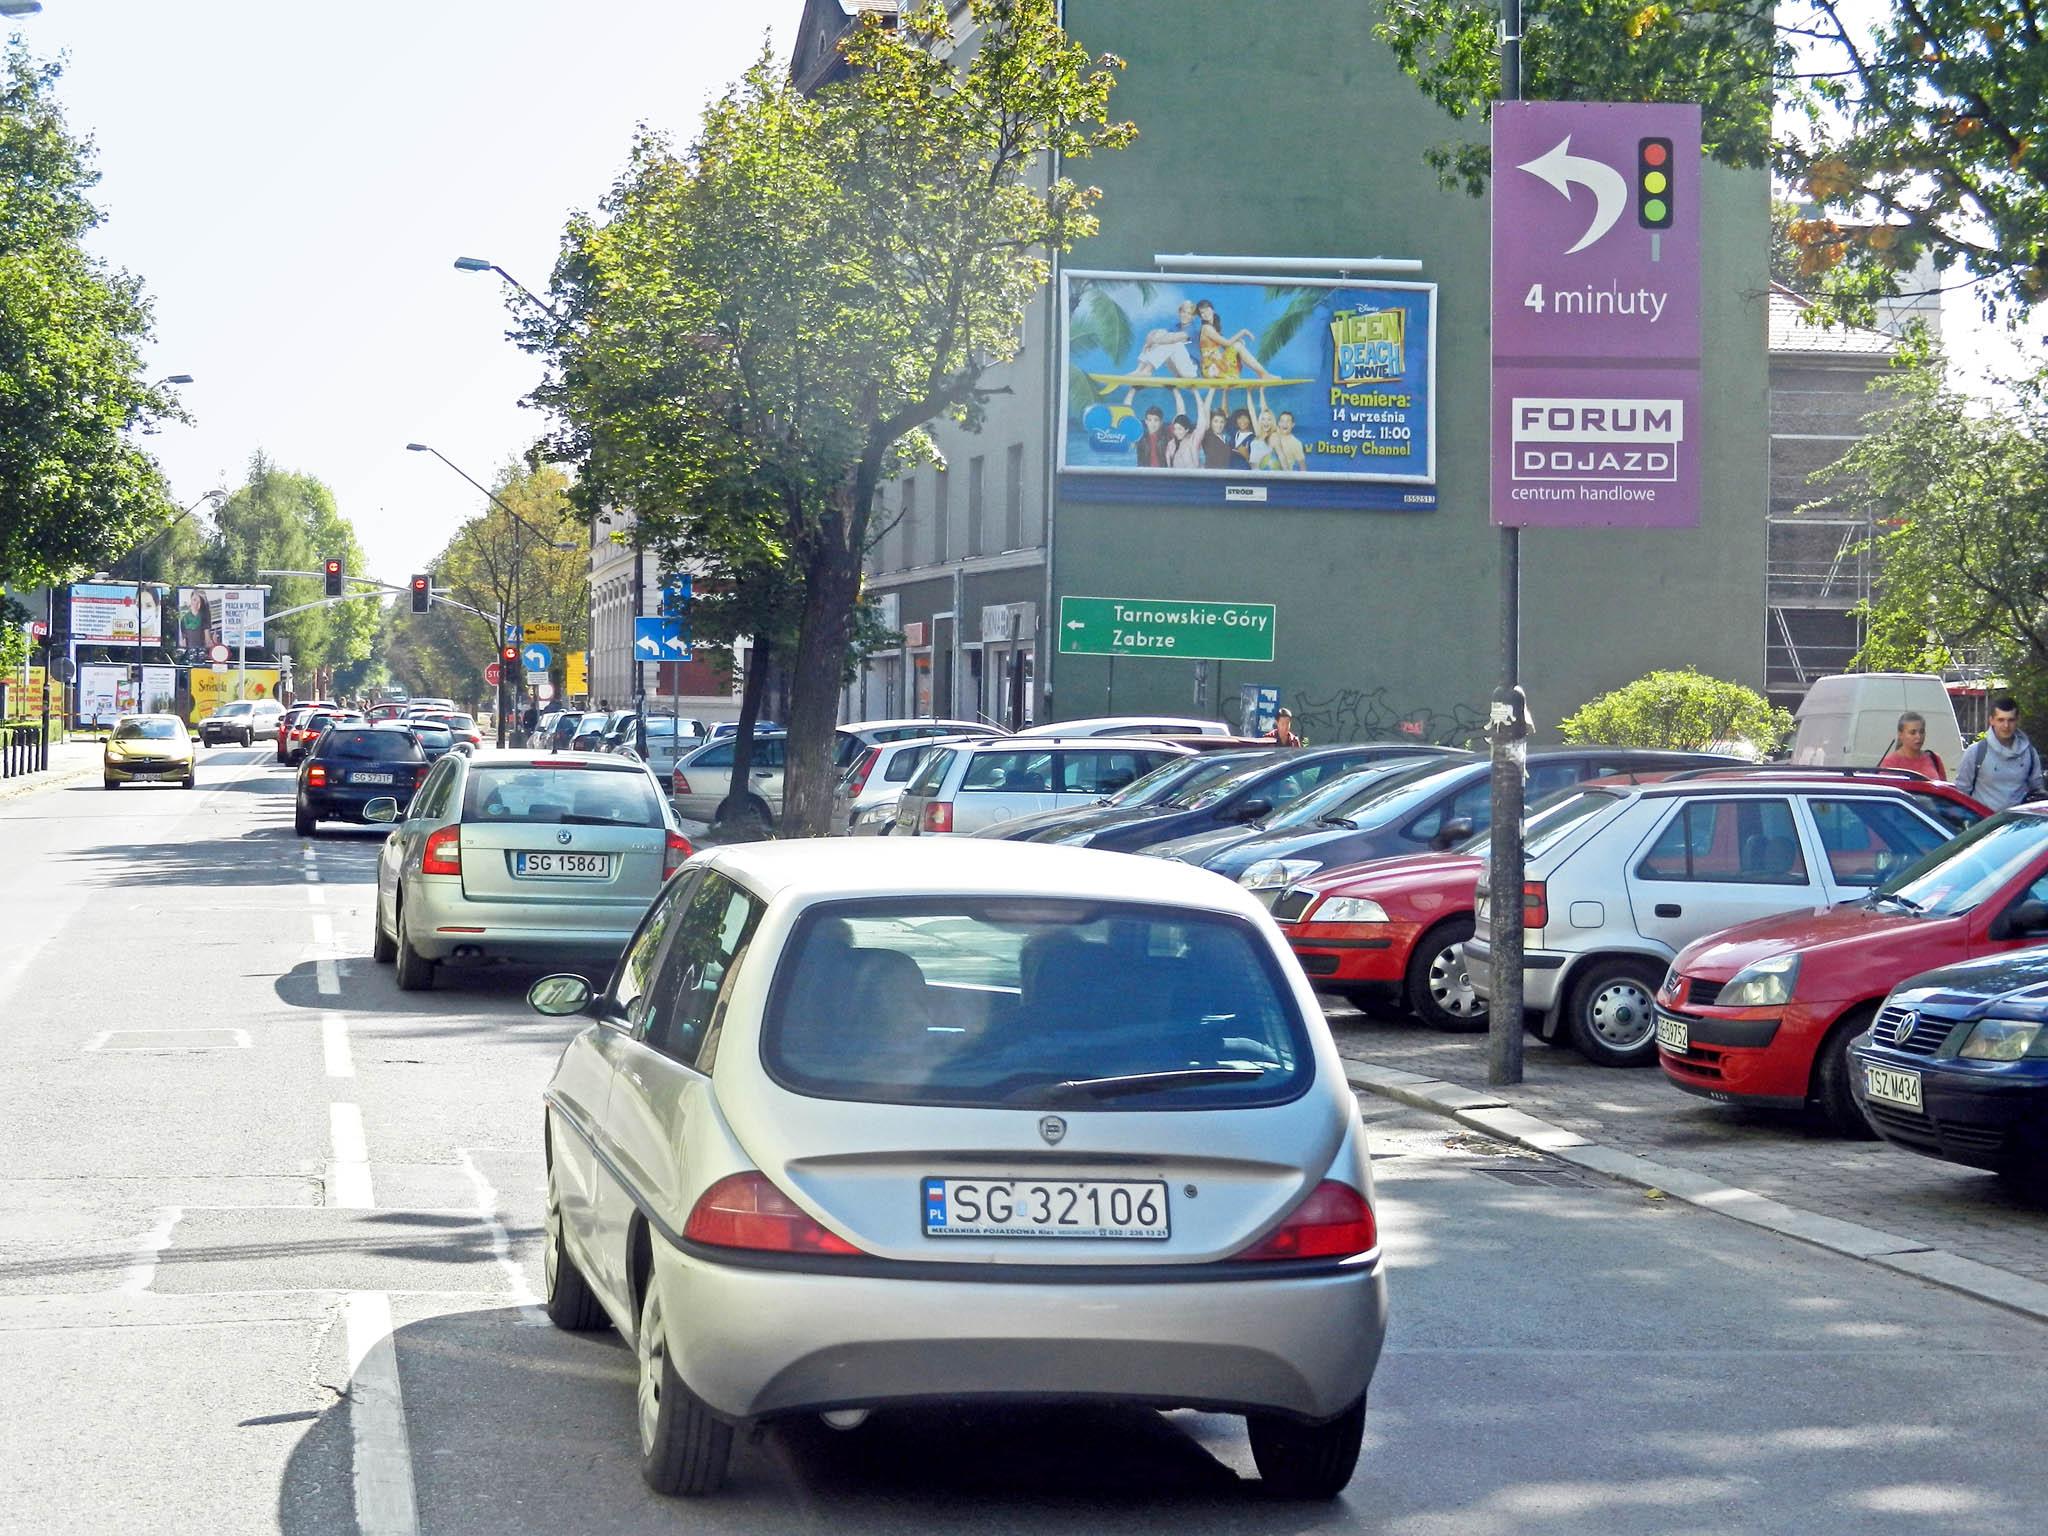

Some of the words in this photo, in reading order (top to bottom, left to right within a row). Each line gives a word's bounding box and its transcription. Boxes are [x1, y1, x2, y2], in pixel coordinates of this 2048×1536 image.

[1524, 283, 1545, 313] 4
[1554, 284, 1668, 323] minuty
[1333, 309, 1400, 343] TEEN
[1339, 341, 1401, 378] BEACH
[1354, 364, 1389, 379] MOVIE
[1330, 387, 1411, 408] Premiera:
[1333, 408, 1346, 421] 14
[1350, 411, 1405, 423] września
[1521, 407, 1672, 432] FORUM
[1331, 428, 1339, 438] o
[1342, 424, 1376, 442] godz.
[1380, 427, 1411, 439] 11:00
[1317, 440, 1357, 458] Disney
[1362, 441, 1411, 455] Channel
[1524, 451, 1669, 471] DOJAZD
[1511, 487, 1576, 500] centrum
[1580, 484, 1656, 501] handlowe
[535, 624, 560, 632] Objazd
[1112, 630, 1175, 647] Zabrze
[528, 855, 552, 870] SG
[559, 856, 605, 872] 1586J
[1869, 1069, 1889, 1096] TSZ
[1891, 1074, 1918, 1103] M434
[930, 1209, 944, 1220] PL
[953, 1185, 1012, 1223] SG
[1030, 1187, 1158, 1226] 32106
